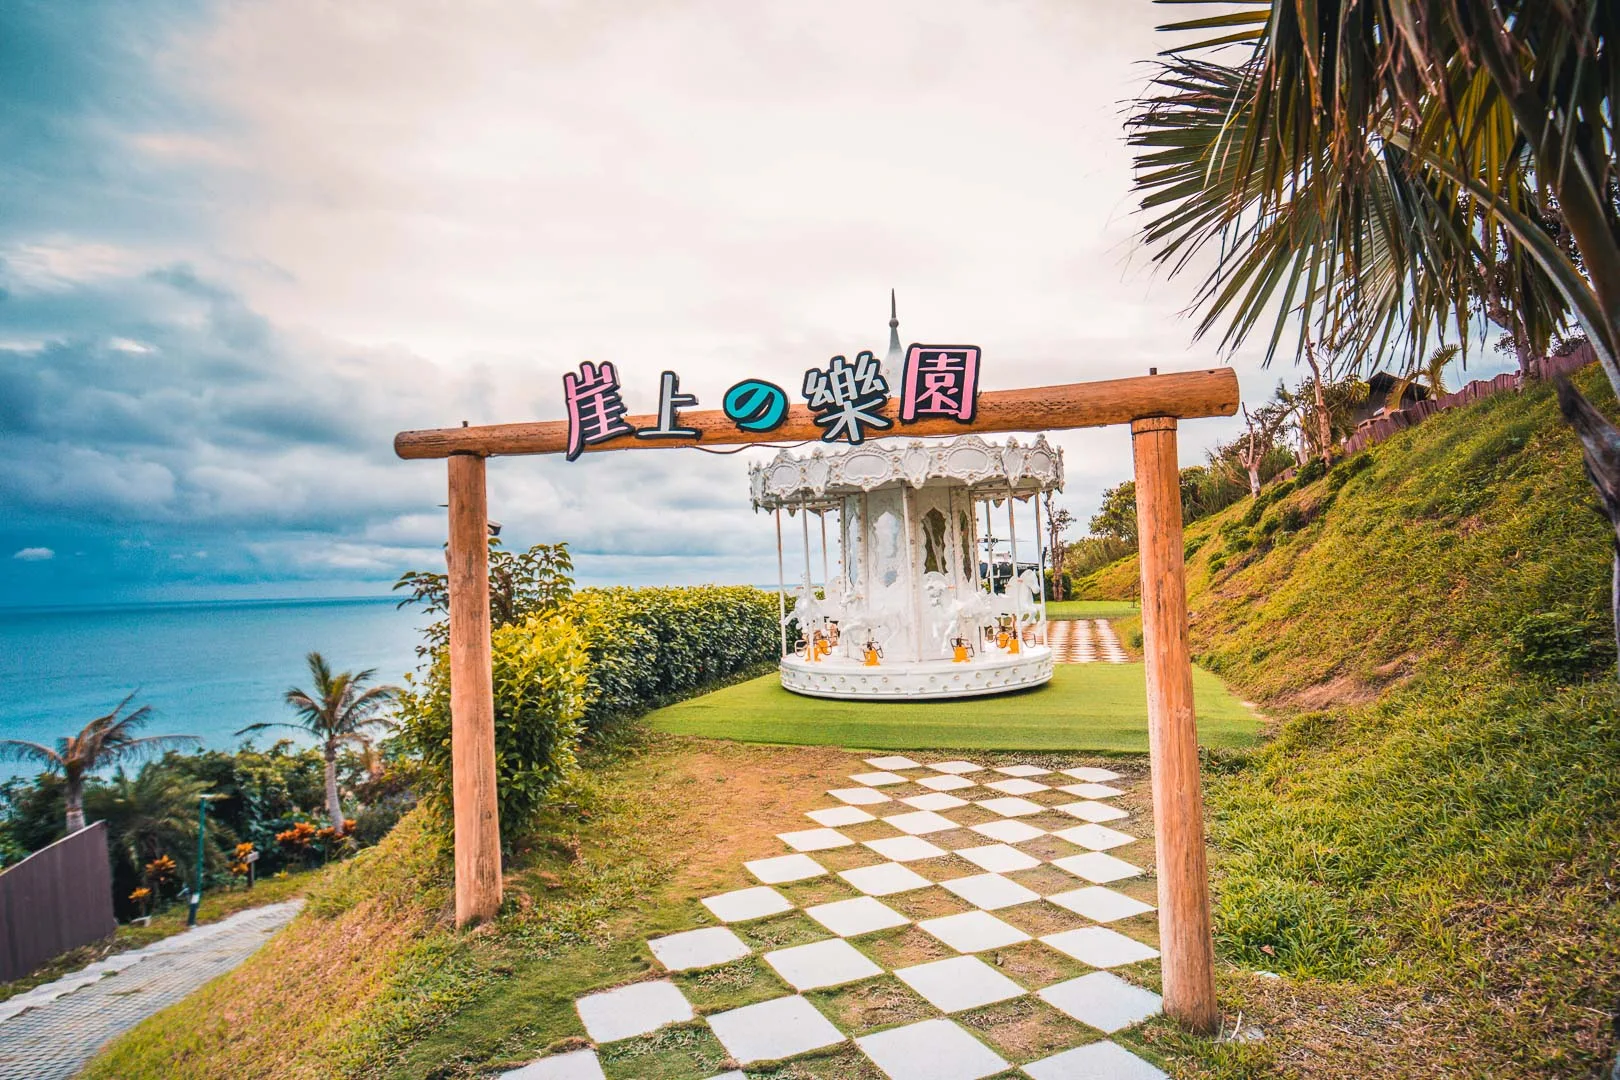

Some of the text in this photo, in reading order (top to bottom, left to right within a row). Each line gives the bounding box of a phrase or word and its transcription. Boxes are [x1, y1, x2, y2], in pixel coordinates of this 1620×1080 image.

[563, 344, 981, 460] 崖上の樂園
